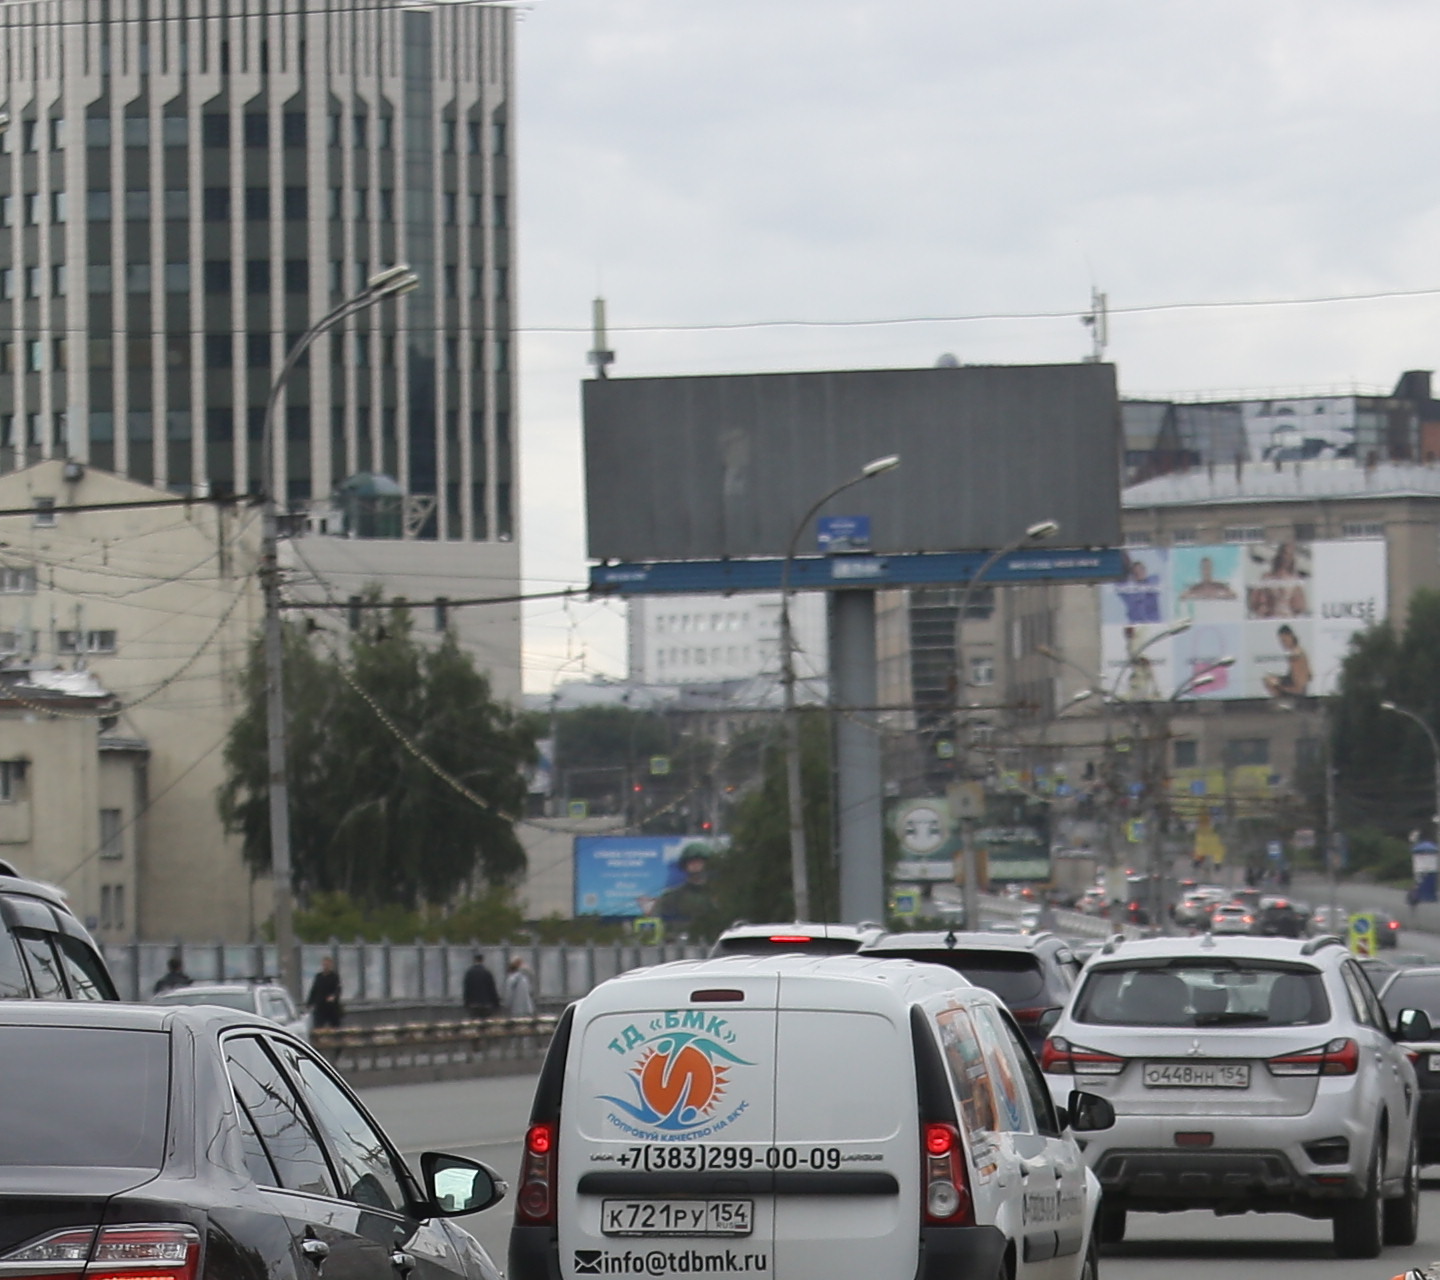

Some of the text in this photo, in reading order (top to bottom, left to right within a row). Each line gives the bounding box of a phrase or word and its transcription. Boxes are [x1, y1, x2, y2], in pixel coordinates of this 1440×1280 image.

[608, 1024, 646, 1055] ТД
[1220, 1067, 1245, 1079] 154
[607, 1100, 750, 1142] ПОПРОБУЙ КАЧЕСТВО НА ВКУС
[617, 1145, 840, 1171] +7(383)299-00-09
[610, 1203, 747, 1228] К721РУ 154
[604, 1250, 767, 1276] info@tdbmk.ru
